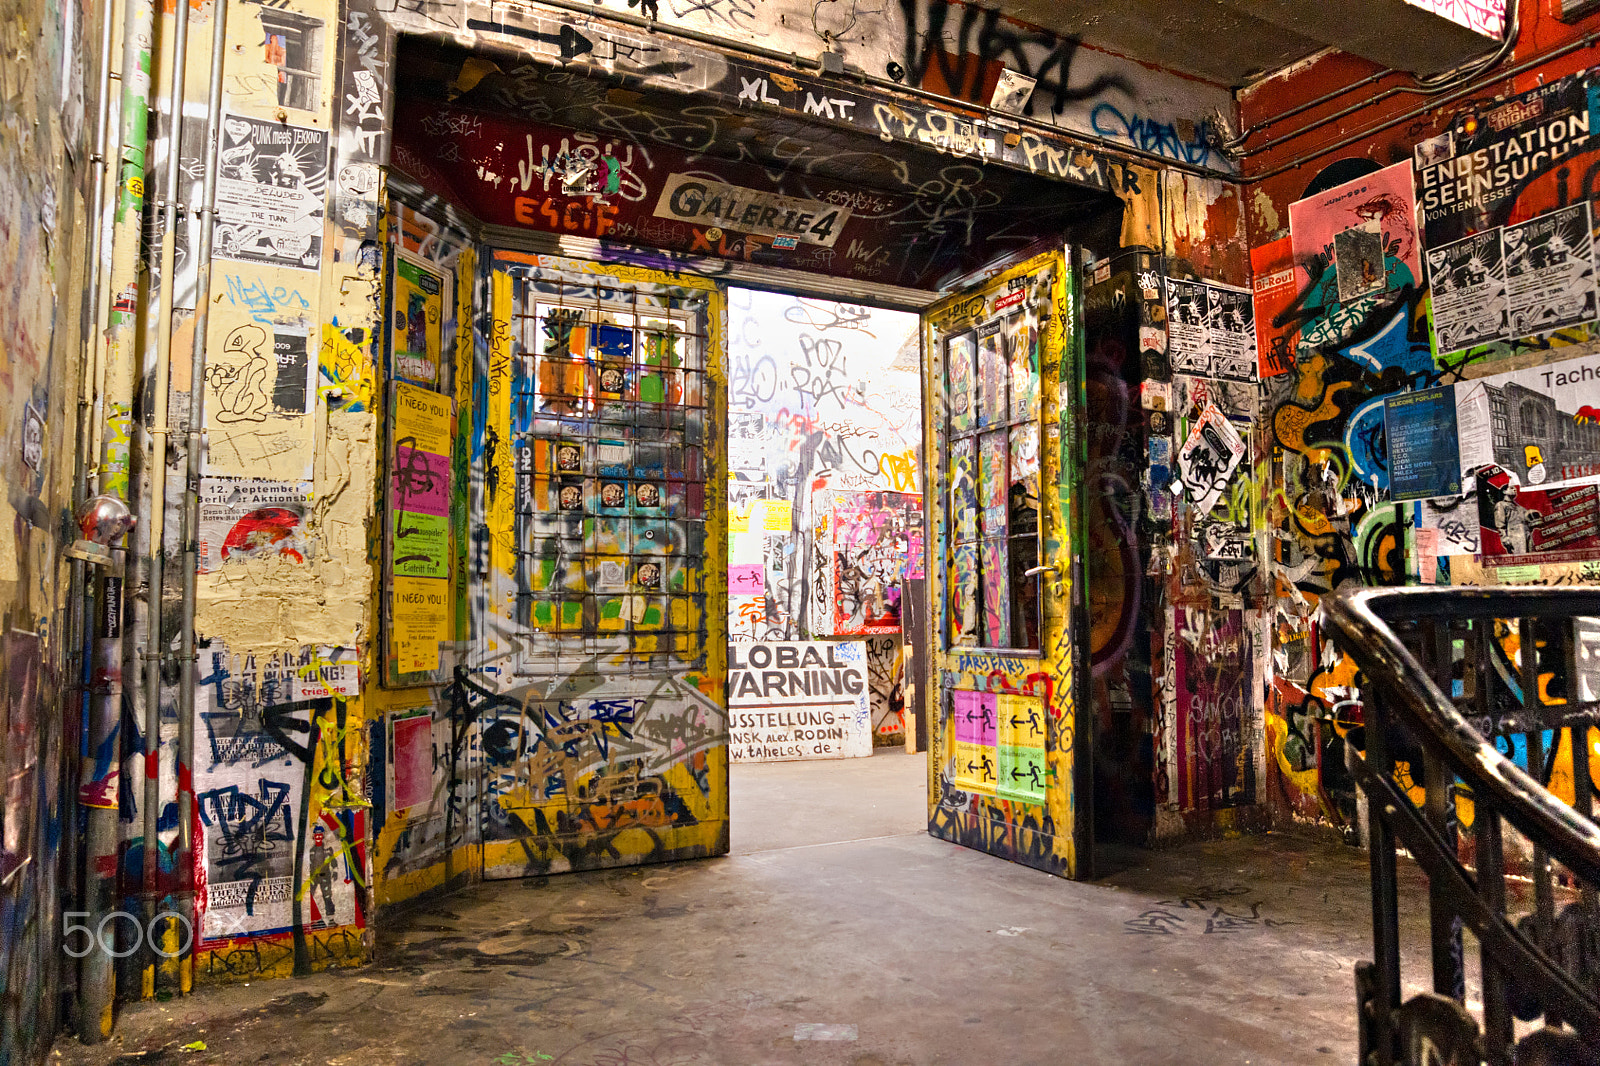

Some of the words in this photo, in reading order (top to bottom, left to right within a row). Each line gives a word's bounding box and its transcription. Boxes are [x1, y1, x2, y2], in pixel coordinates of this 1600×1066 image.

[738, 76, 780, 107] XL
[251, 124, 273, 145] PUNK
[272, 129, 293, 145] meets
[293, 128, 322, 145] TEKKNO
[1422, 110, 1591, 189] ENDSTATION
[253, 187, 305, 201] DELUDED
[1426, 208, 1447, 222] VON
[1450, 184, 1519, 215] TENNESSE
[250, 211, 265, 220] THE
[1255, 271, 1293, 292] Bi-Rout
[405, 398, 428, 412] NEED
[429, 404, 445, 417] YOU
[209, 485, 228, 494] 12.
[233, 485, 299, 494] September
[196, 494, 248, 504] Berlier
[402, 592, 425, 604] NEED
[427, 594, 442, 605] YOU
[728, 645, 848, 669] LOBAL
[728, 711, 835, 729] USSTELLUNG
[793, 727, 843, 742] RODIN
[235, 883, 292, 895] FAULISTS
[210, 898, 245, 906] ORIGINA
